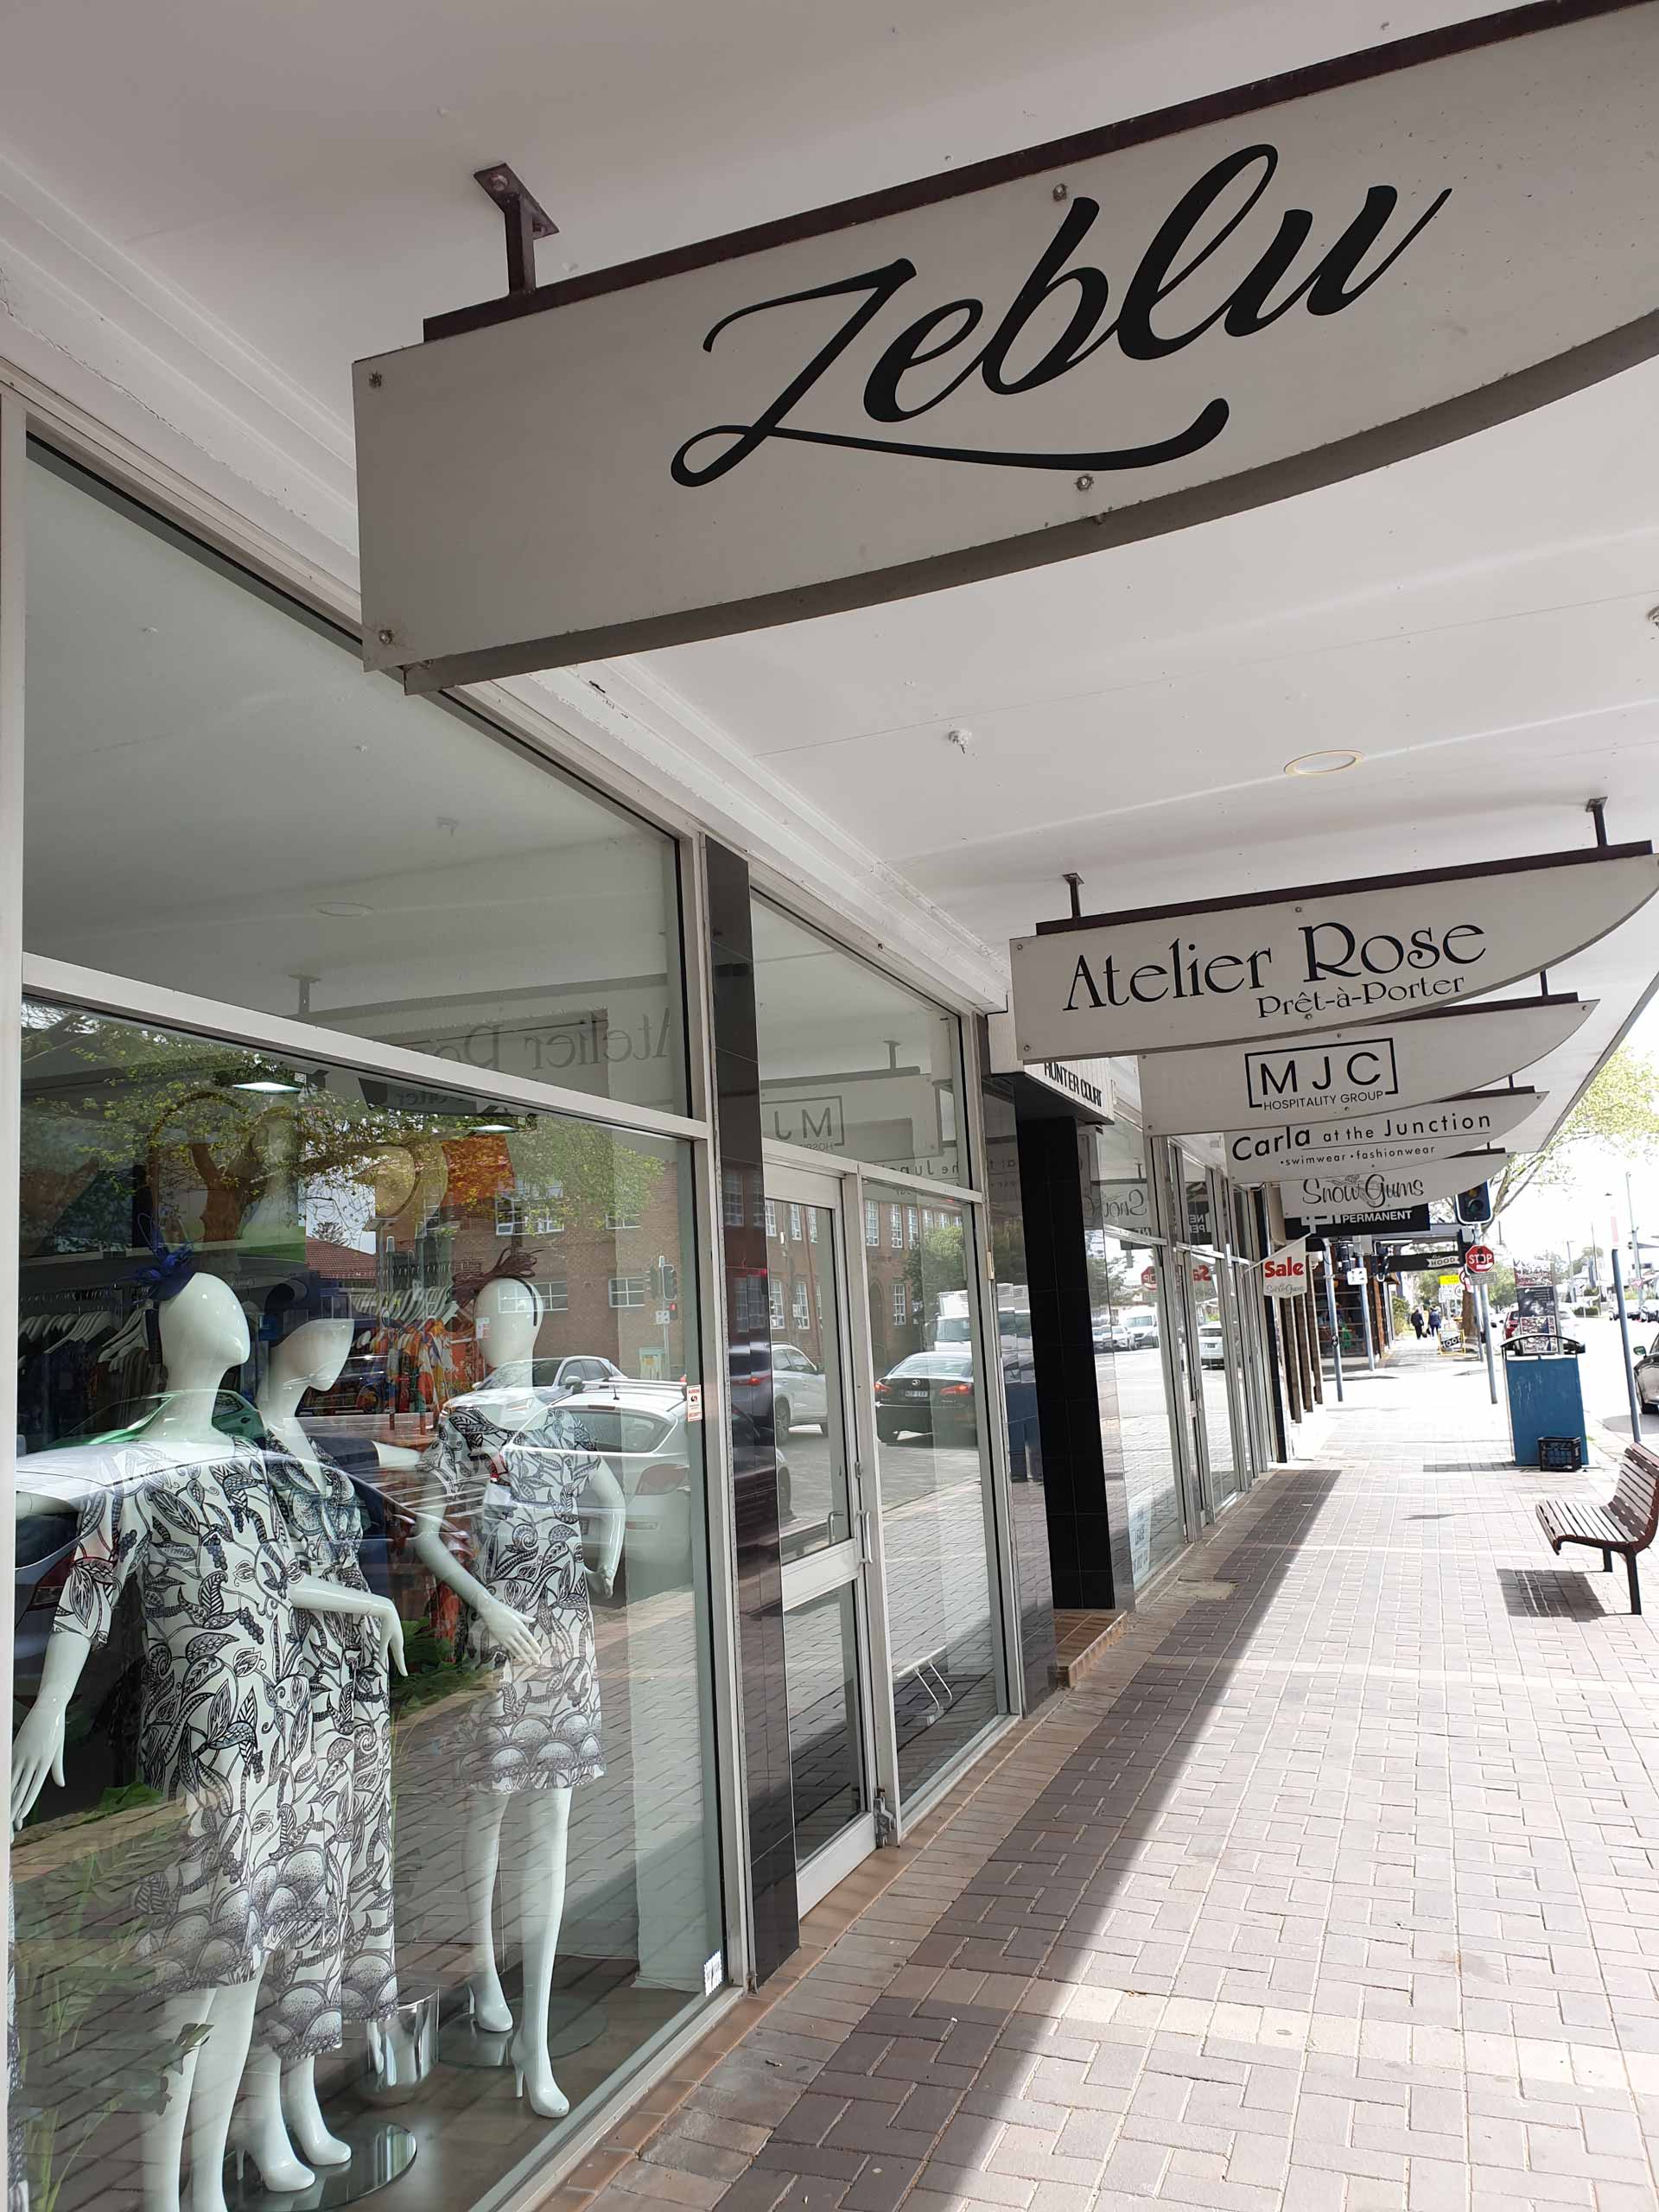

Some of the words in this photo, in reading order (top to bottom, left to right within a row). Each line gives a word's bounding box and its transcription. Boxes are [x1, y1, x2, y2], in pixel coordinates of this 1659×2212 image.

[671, 143, 1452, 487] Zeblu
[1063, 938, 1272, 1011] Atelier
[1298, 922, 1486, 982] Rose
[1256, 977, 1465, 1018] Prêt-à-Porter
[1044, 1061, 1079, 1095] HUNTER
[1081, 1079, 1102, 1108] COURT
[1263, 1095, 1337, 1111] HOSPITALITY
[1340, 1090, 1383, 1103] GROUP
[1232, 1126, 1310, 1161] Carla
[1323, 1128, 1339, 1142] at
[1346, 1127, 1374, 1140] the
[1384, 1113, 1491, 1136] Junction
[1302, 1179, 1361, 1205] Snow
[1365, 1174, 1425, 1208] Gums
[1342, 1210, 1413, 1224] PERMANENT
[1264, 1256, 1305, 1278] Sale
[1431, 1257, 1455, 1266] HOOD
[1469, 1254, 1493, 1265] STOP
